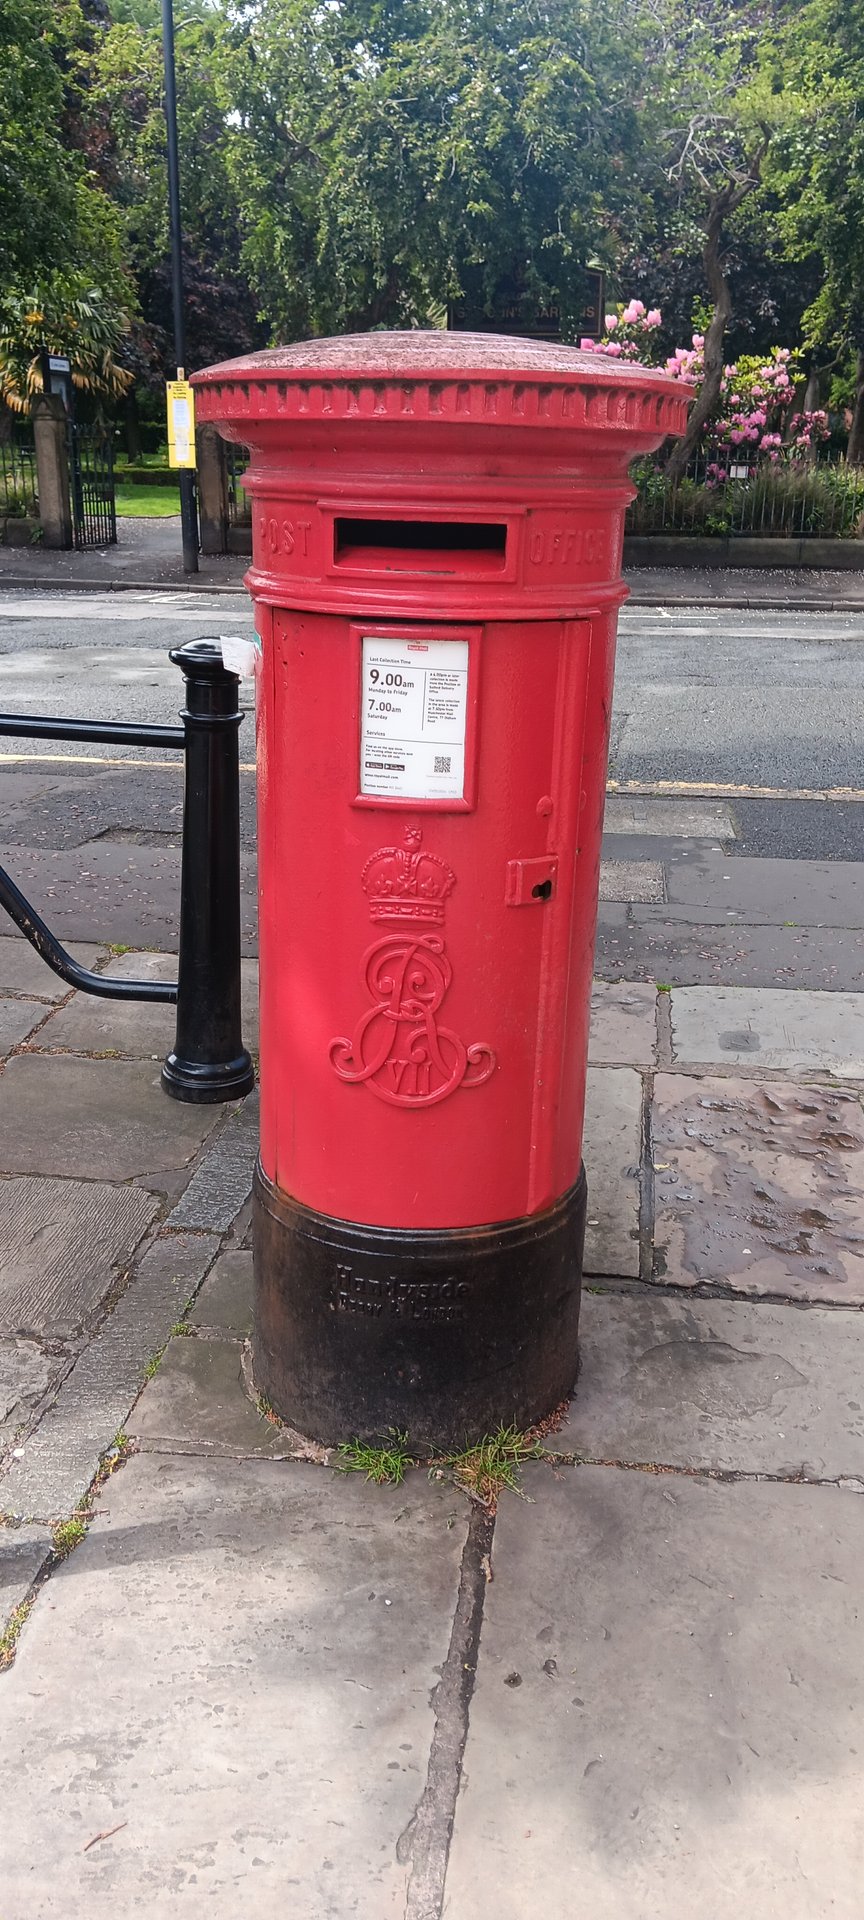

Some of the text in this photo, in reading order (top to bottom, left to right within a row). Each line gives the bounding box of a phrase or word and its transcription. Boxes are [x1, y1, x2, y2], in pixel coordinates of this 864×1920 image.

[260, 518, 606, 566] POST OFFICE
[370, 669, 414, 688] 9.00am
[368, 699, 401, 713] 7.00am
[386, 1060, 432, 1095] VII
[336, 1264, 470, 1299] Handyside
